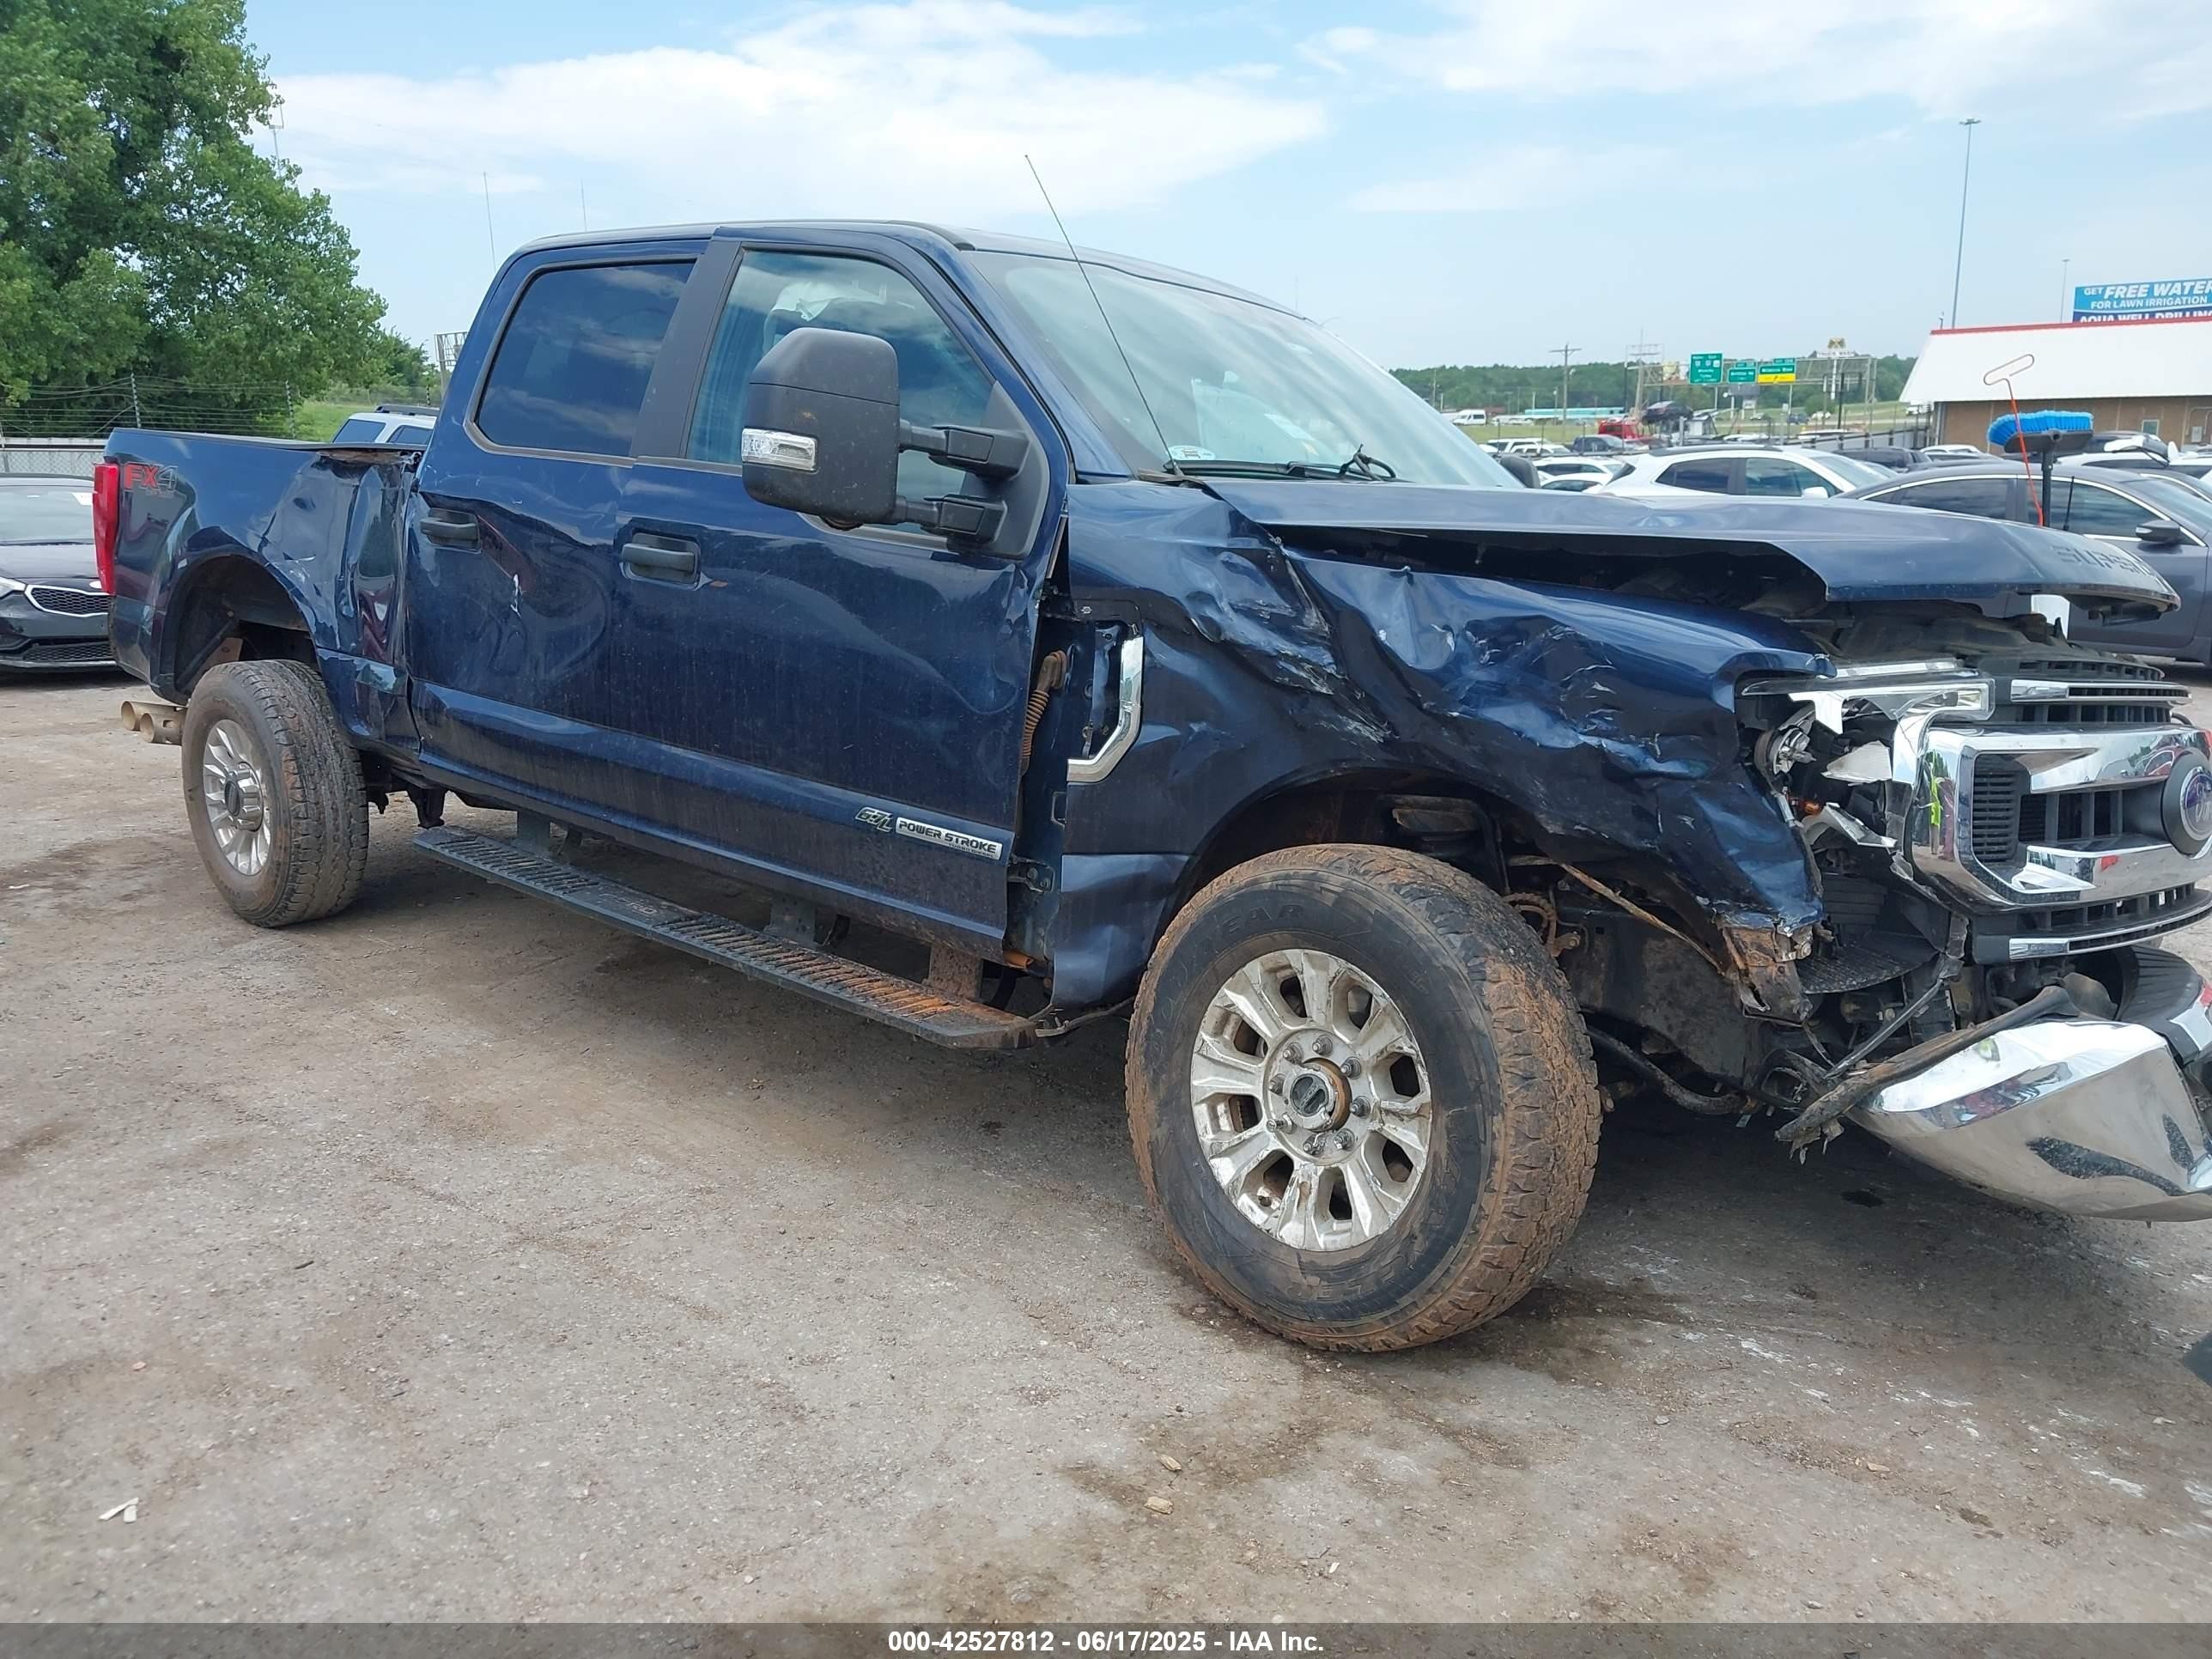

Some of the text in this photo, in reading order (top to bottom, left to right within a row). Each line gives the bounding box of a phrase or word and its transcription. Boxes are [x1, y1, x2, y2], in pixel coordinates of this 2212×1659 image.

[2083, 288, 2105, 296] GET
[2104, 285, 2150, 299] FREE
[2091, 295, 2208, 309] FOR LAWN IRRIGATION
[124, 464, 177, 490] FX4
[898, 820, 997, 854] POWER STROKE
